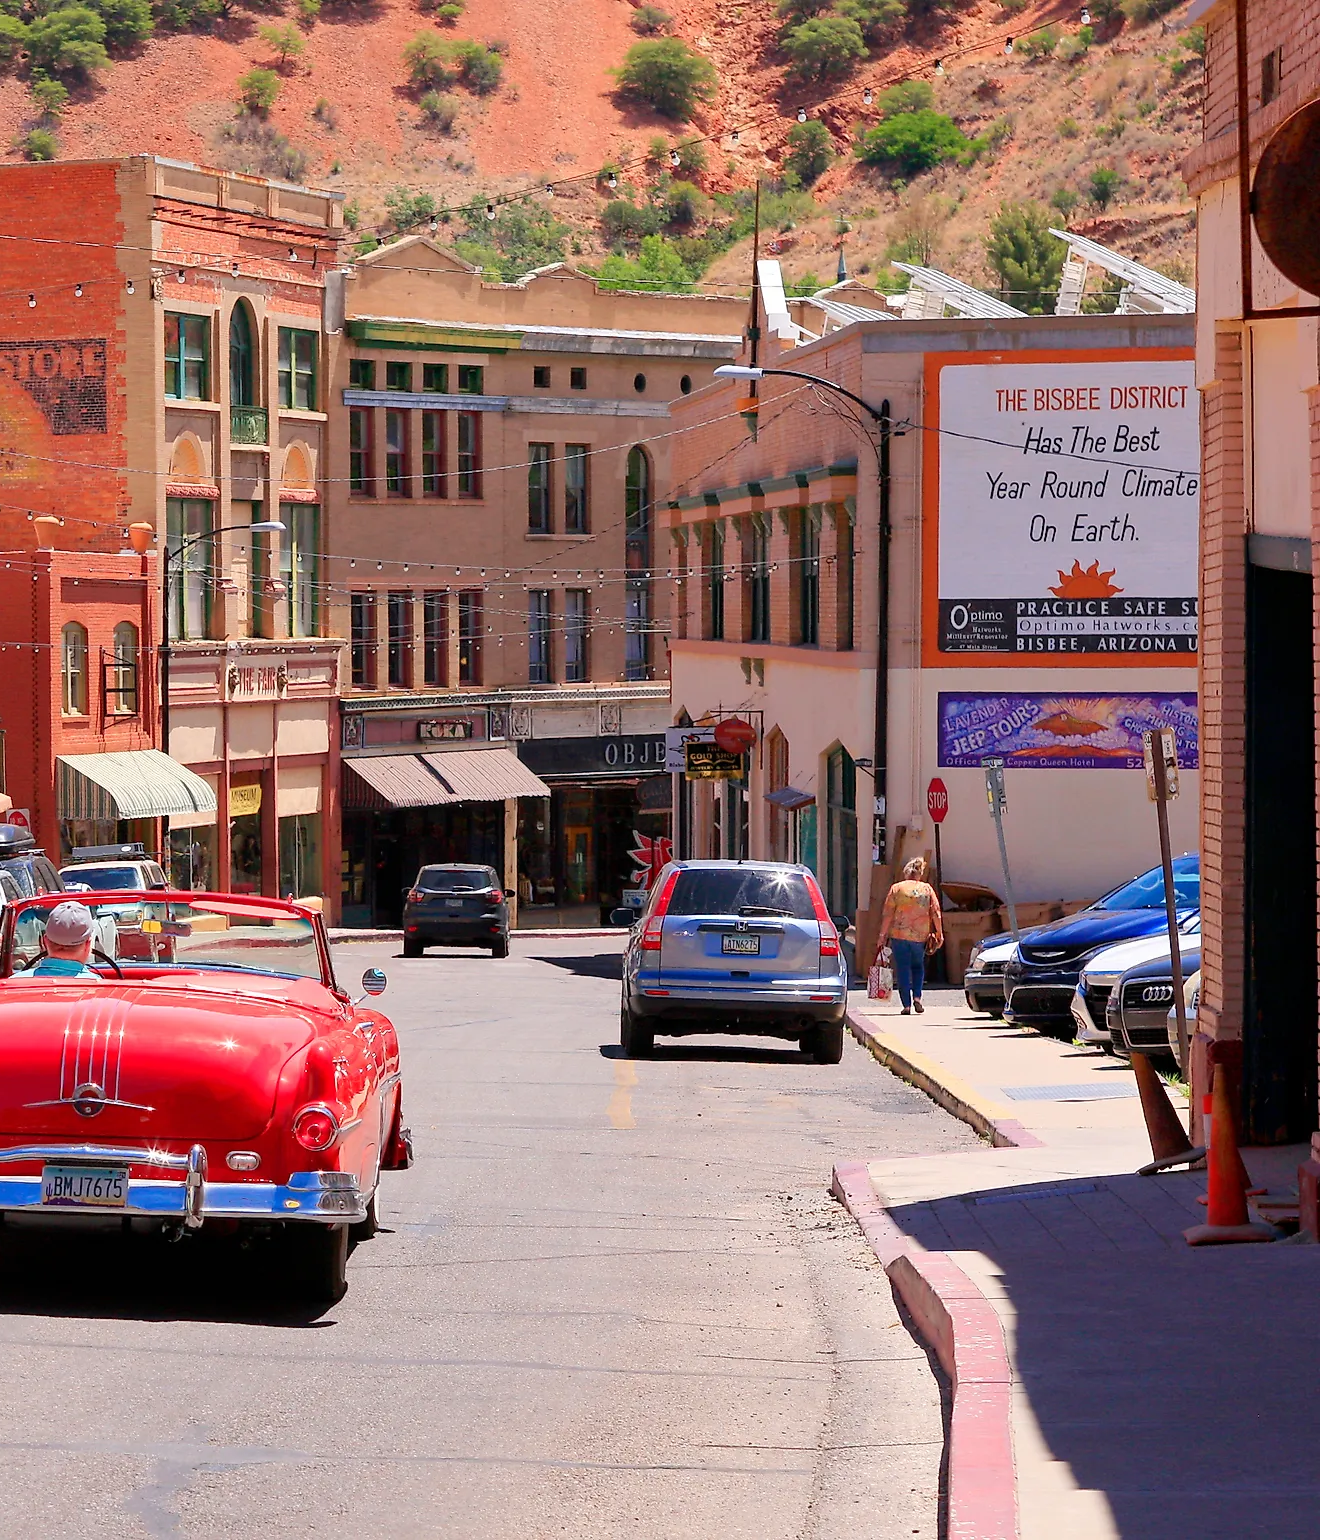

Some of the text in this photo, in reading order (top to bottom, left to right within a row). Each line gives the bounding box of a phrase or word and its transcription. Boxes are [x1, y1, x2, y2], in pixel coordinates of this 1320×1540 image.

[995, 385, 1188, 412] THE BISBEE DISTRICT
[1023, 425, 1160, 454] Has The Best
[986, 468, 1198, 499] Year Round Climate
[1029, 513, 1140, 542] On Earth.
[1017, 601, 1109, 615] PRACTICE
[1124, 601, 1166, 615] SAFE
[1019, 619, 1085, 634] Optimo
[1017, 637, 1086, 653] BISBEE,
[1098, 637, 1177, 651] ARIZONA
[239, 667, 276, 691] THE FAIR
[945, 697, 1010, 732] LAVENDER
[951, 700, 1039, 756] JEEP TOURS
[946, 757, 977, 766] Office
[1040, 757, 1067, 766] Queen
[1070, 757, 1095, 766] Hotel
[232, 788, 257, 802] MUSEUM
[928, 792, 947, 809] STOP
[727, 939, 758, 950] ATN6275
[53, 1176, 123, 1198] BMJ7675
